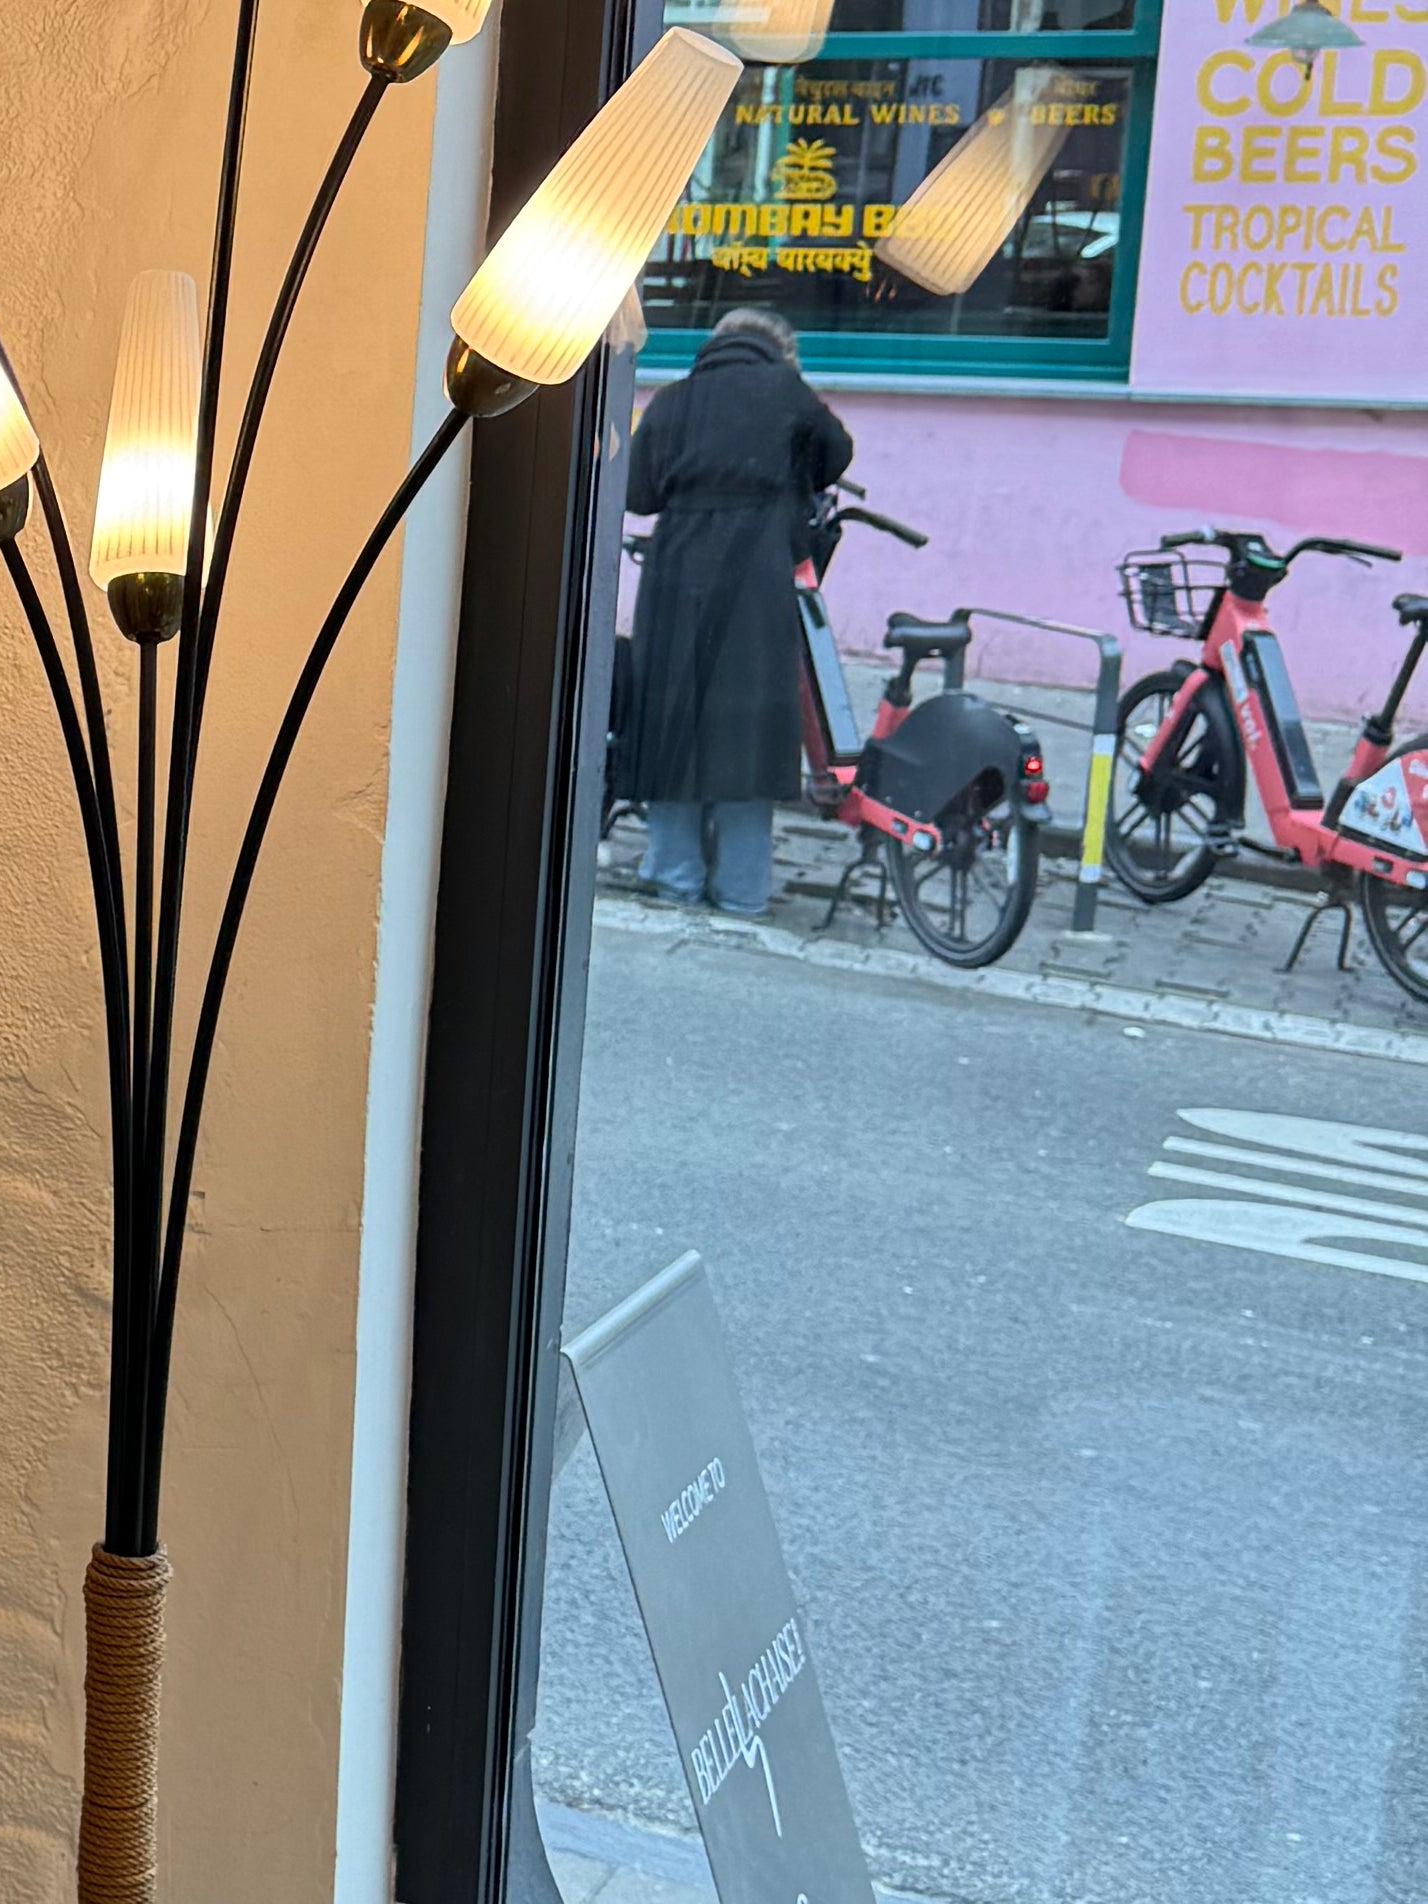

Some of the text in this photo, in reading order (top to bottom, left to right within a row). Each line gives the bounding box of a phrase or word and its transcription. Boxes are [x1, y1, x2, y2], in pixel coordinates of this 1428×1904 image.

[1196, 50, 1427, 117] COLD
[735, 103, 1119, 126] NATURAL WINES BEERS
[1191, 125, 1418, 185] BEERS
[1182, 203, 1407, 253] TROPICAL
[1179, 261, 1399, 318] COCKTAILS
[660, 1457, 726, 1544] WELCOME TO
